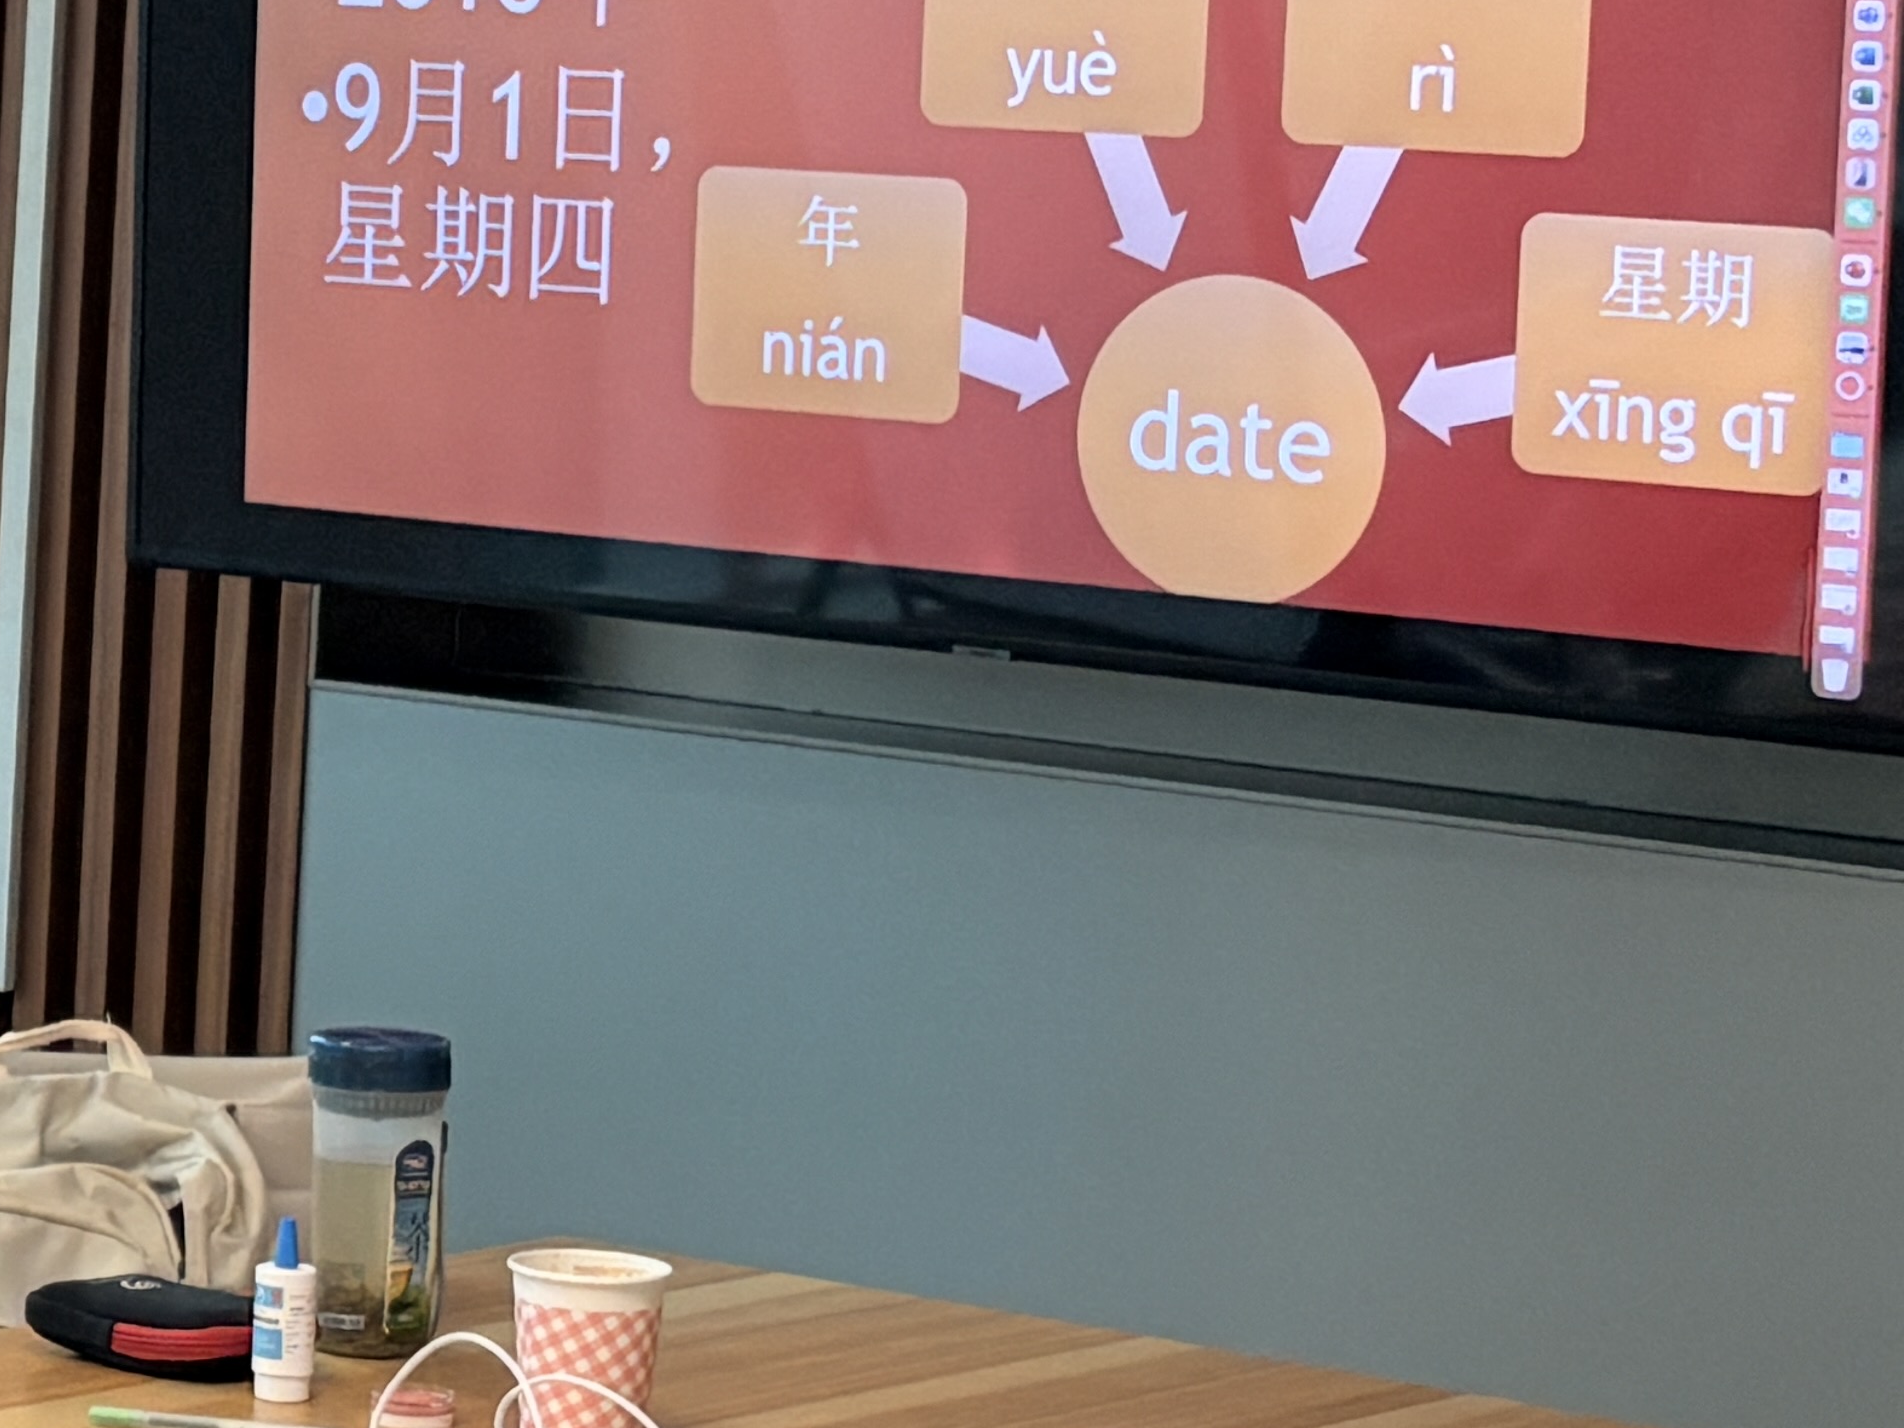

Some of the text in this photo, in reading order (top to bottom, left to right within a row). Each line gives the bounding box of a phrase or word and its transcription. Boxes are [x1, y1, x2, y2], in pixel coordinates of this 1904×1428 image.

[1006, 31, 1118, 107] yuè
[1408, 45, 1456, 114] rì
[324, 181, 614, 305] 星期四
[797, 195, 861, 267] 年
[1598, 245, 1754, 330] 星期
[763, 316, 886, 383] nián
[1129, 389, 1332, 484] date
[1551, 379, 1796, 469] xīng qī
